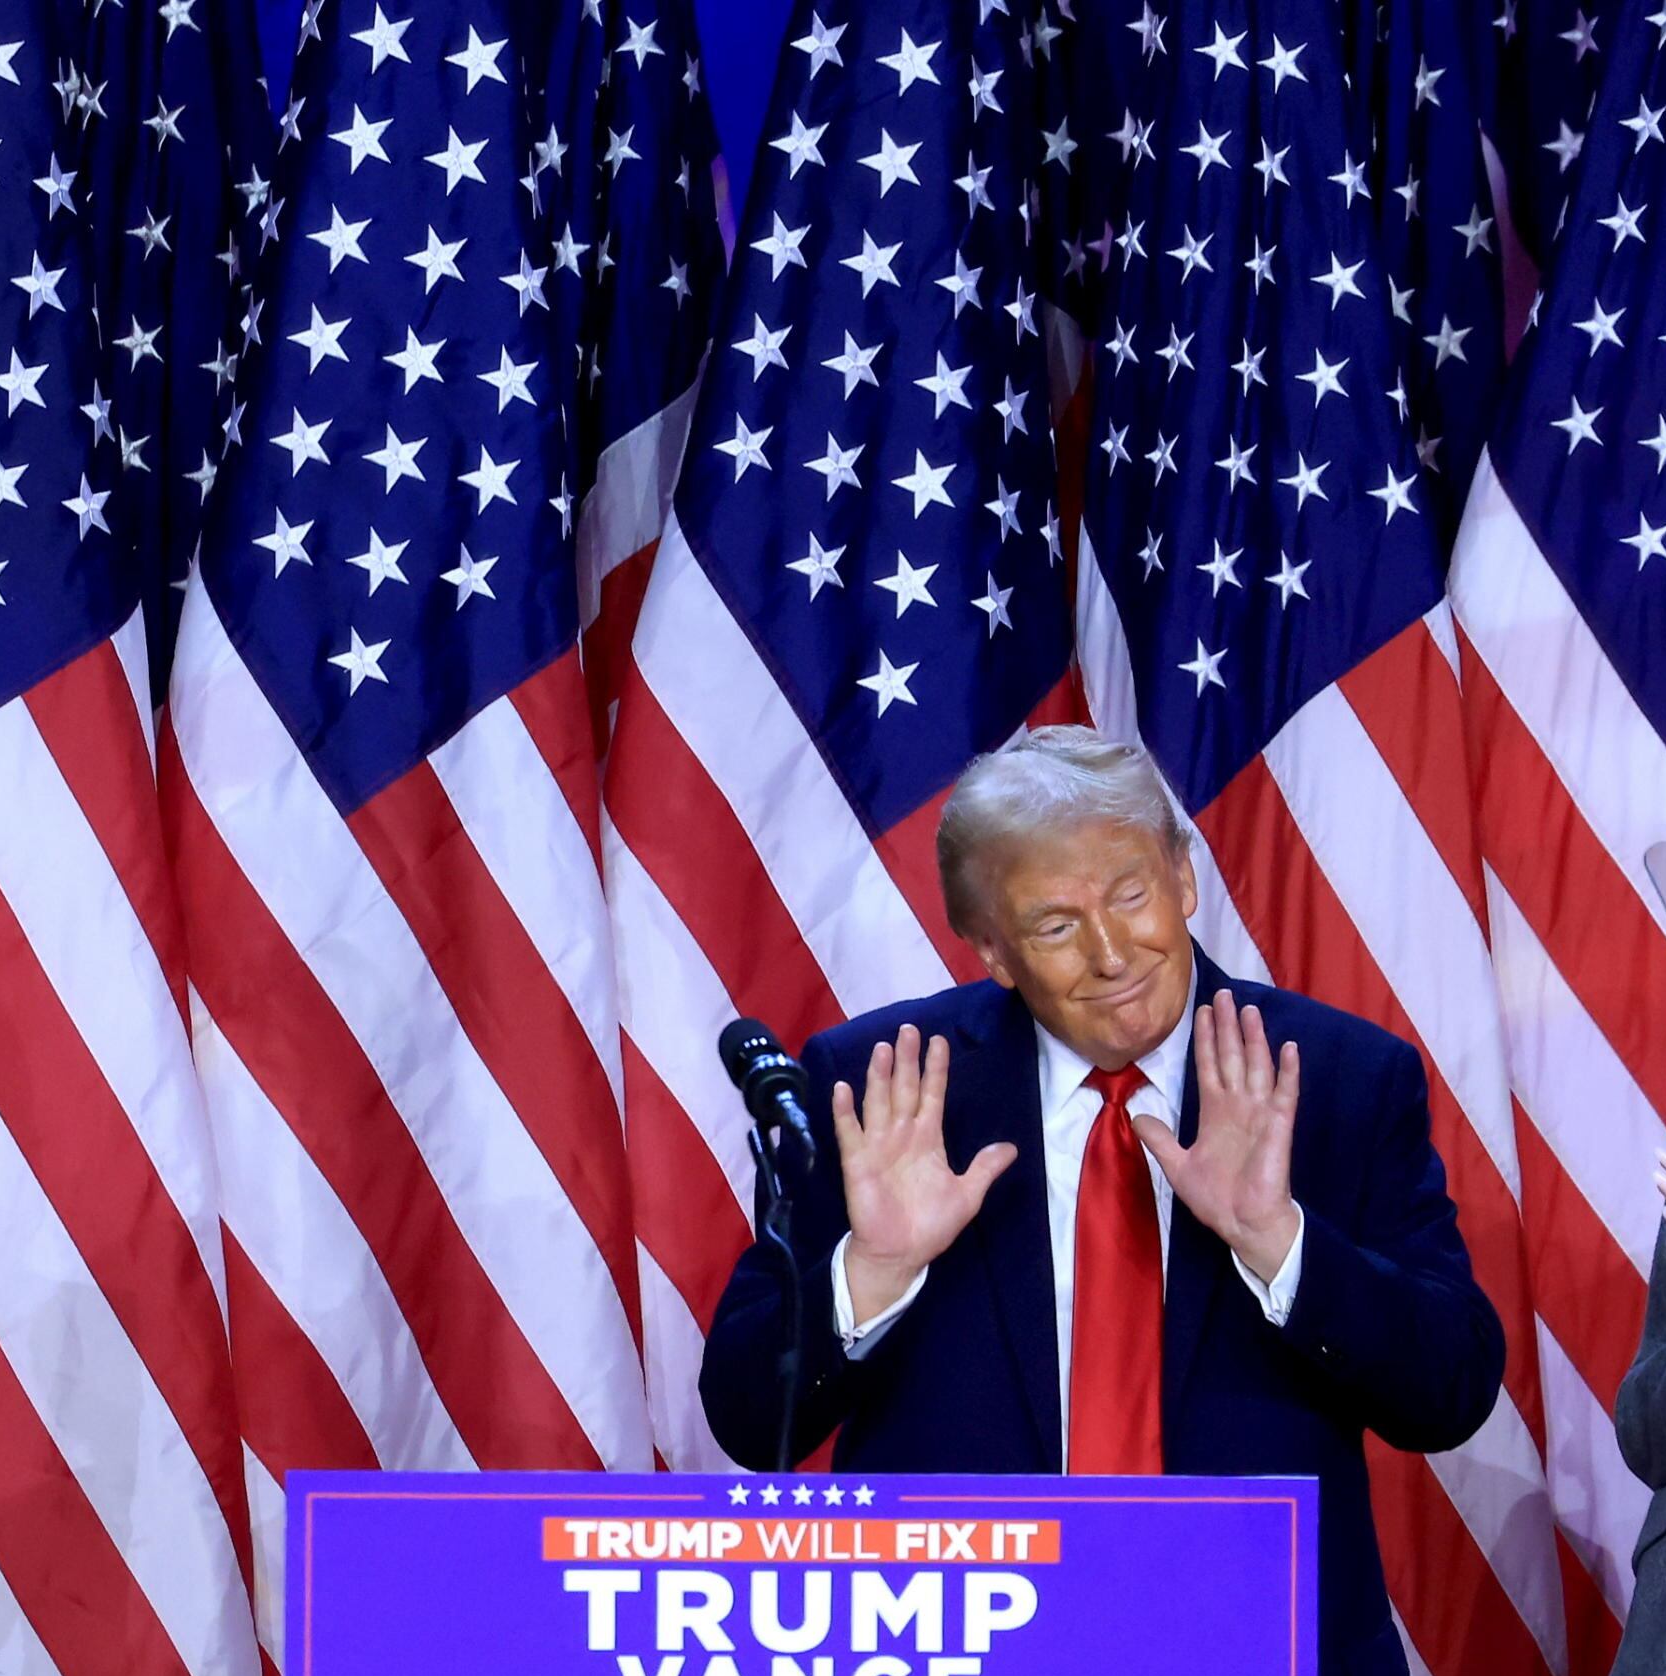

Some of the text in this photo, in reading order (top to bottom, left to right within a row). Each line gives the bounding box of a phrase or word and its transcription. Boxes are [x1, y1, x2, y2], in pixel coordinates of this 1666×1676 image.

[564, 1520, 1039, 1561] TRUMP WILL FIX IT
[563, 1569, 1038, 1653] TRUMP
